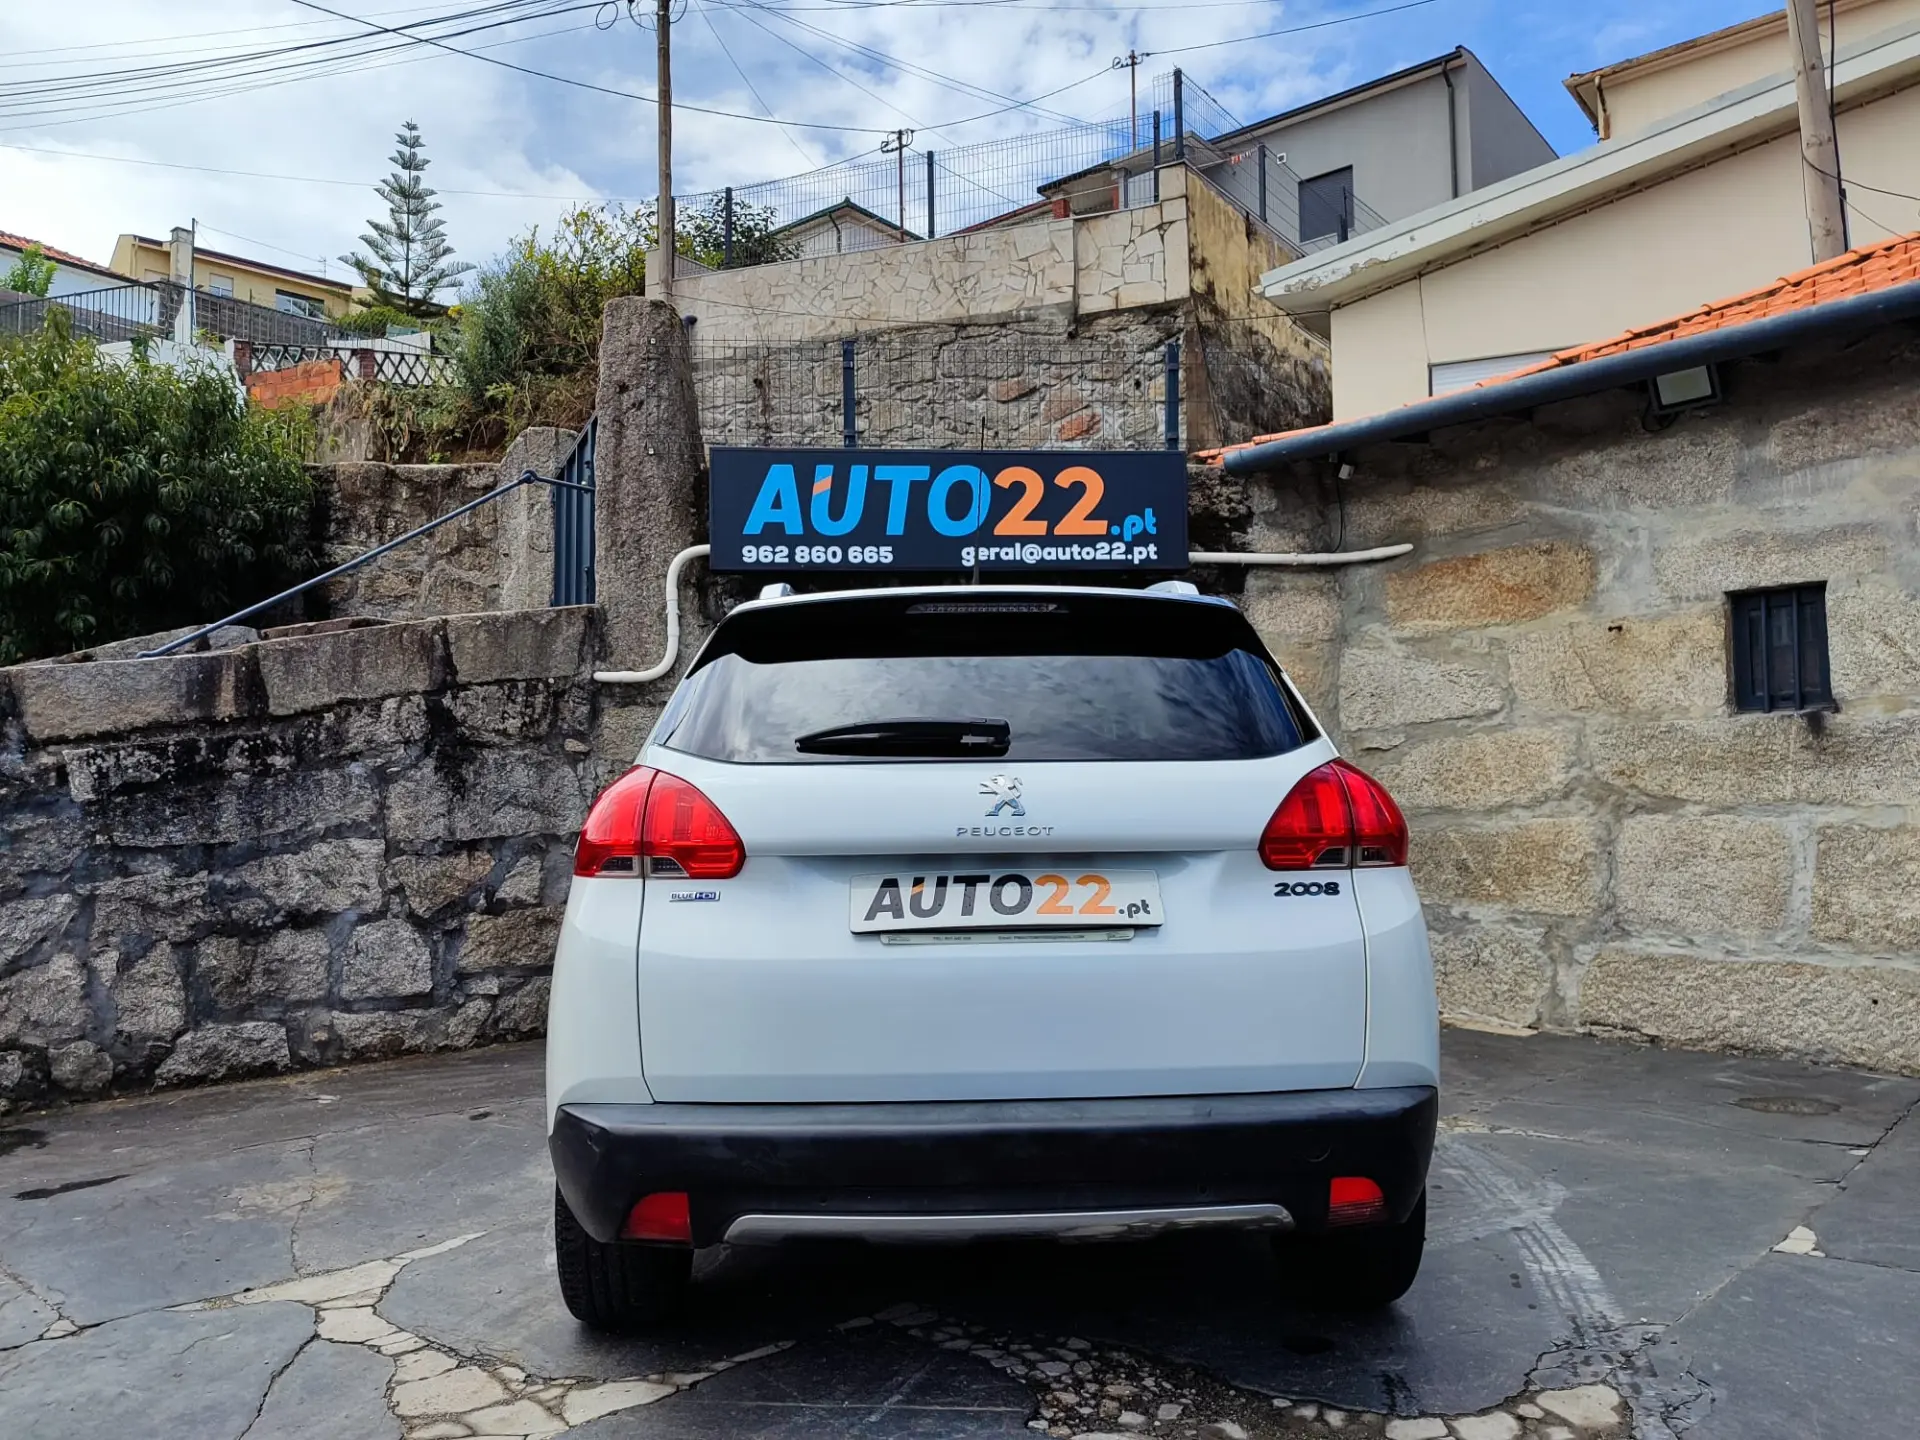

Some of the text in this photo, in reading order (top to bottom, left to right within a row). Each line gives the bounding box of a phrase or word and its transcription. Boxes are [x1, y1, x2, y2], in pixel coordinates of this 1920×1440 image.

[742, 463, 1158, 542] AUTO22.pt
[742, 545, 894, 564] 962 860 665
[961, 542, 1158, 567] geral@auto22.pt
[956, 826, 1054, 837] PEUGEOT
[863, 872, 1151, 921] AUTO22.pt
[1273, 881, 1340, 897] 2008
